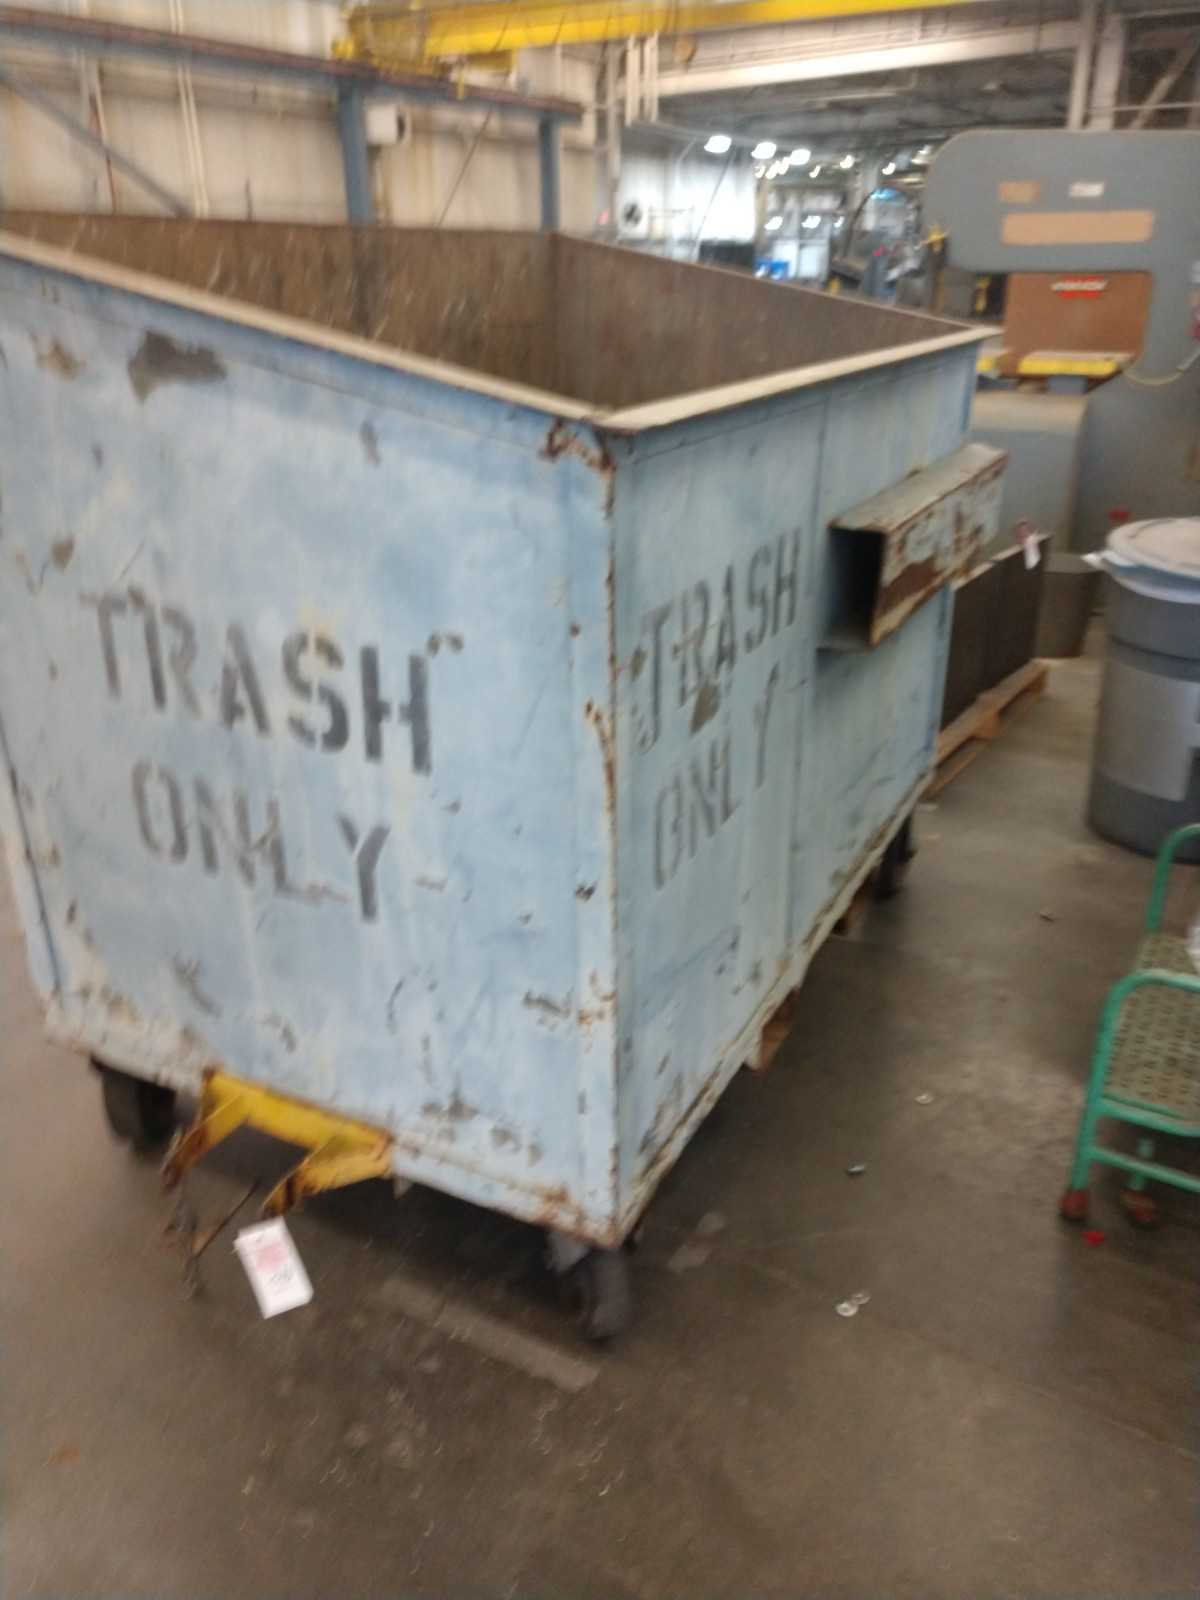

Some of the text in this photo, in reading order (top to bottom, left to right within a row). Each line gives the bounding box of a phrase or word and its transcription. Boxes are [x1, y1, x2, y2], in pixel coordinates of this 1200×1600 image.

[80, 588, 432, 776] TRASH
[637, 530, 799, 753] TRASH
[131, 761, 390, 921] ONLY
